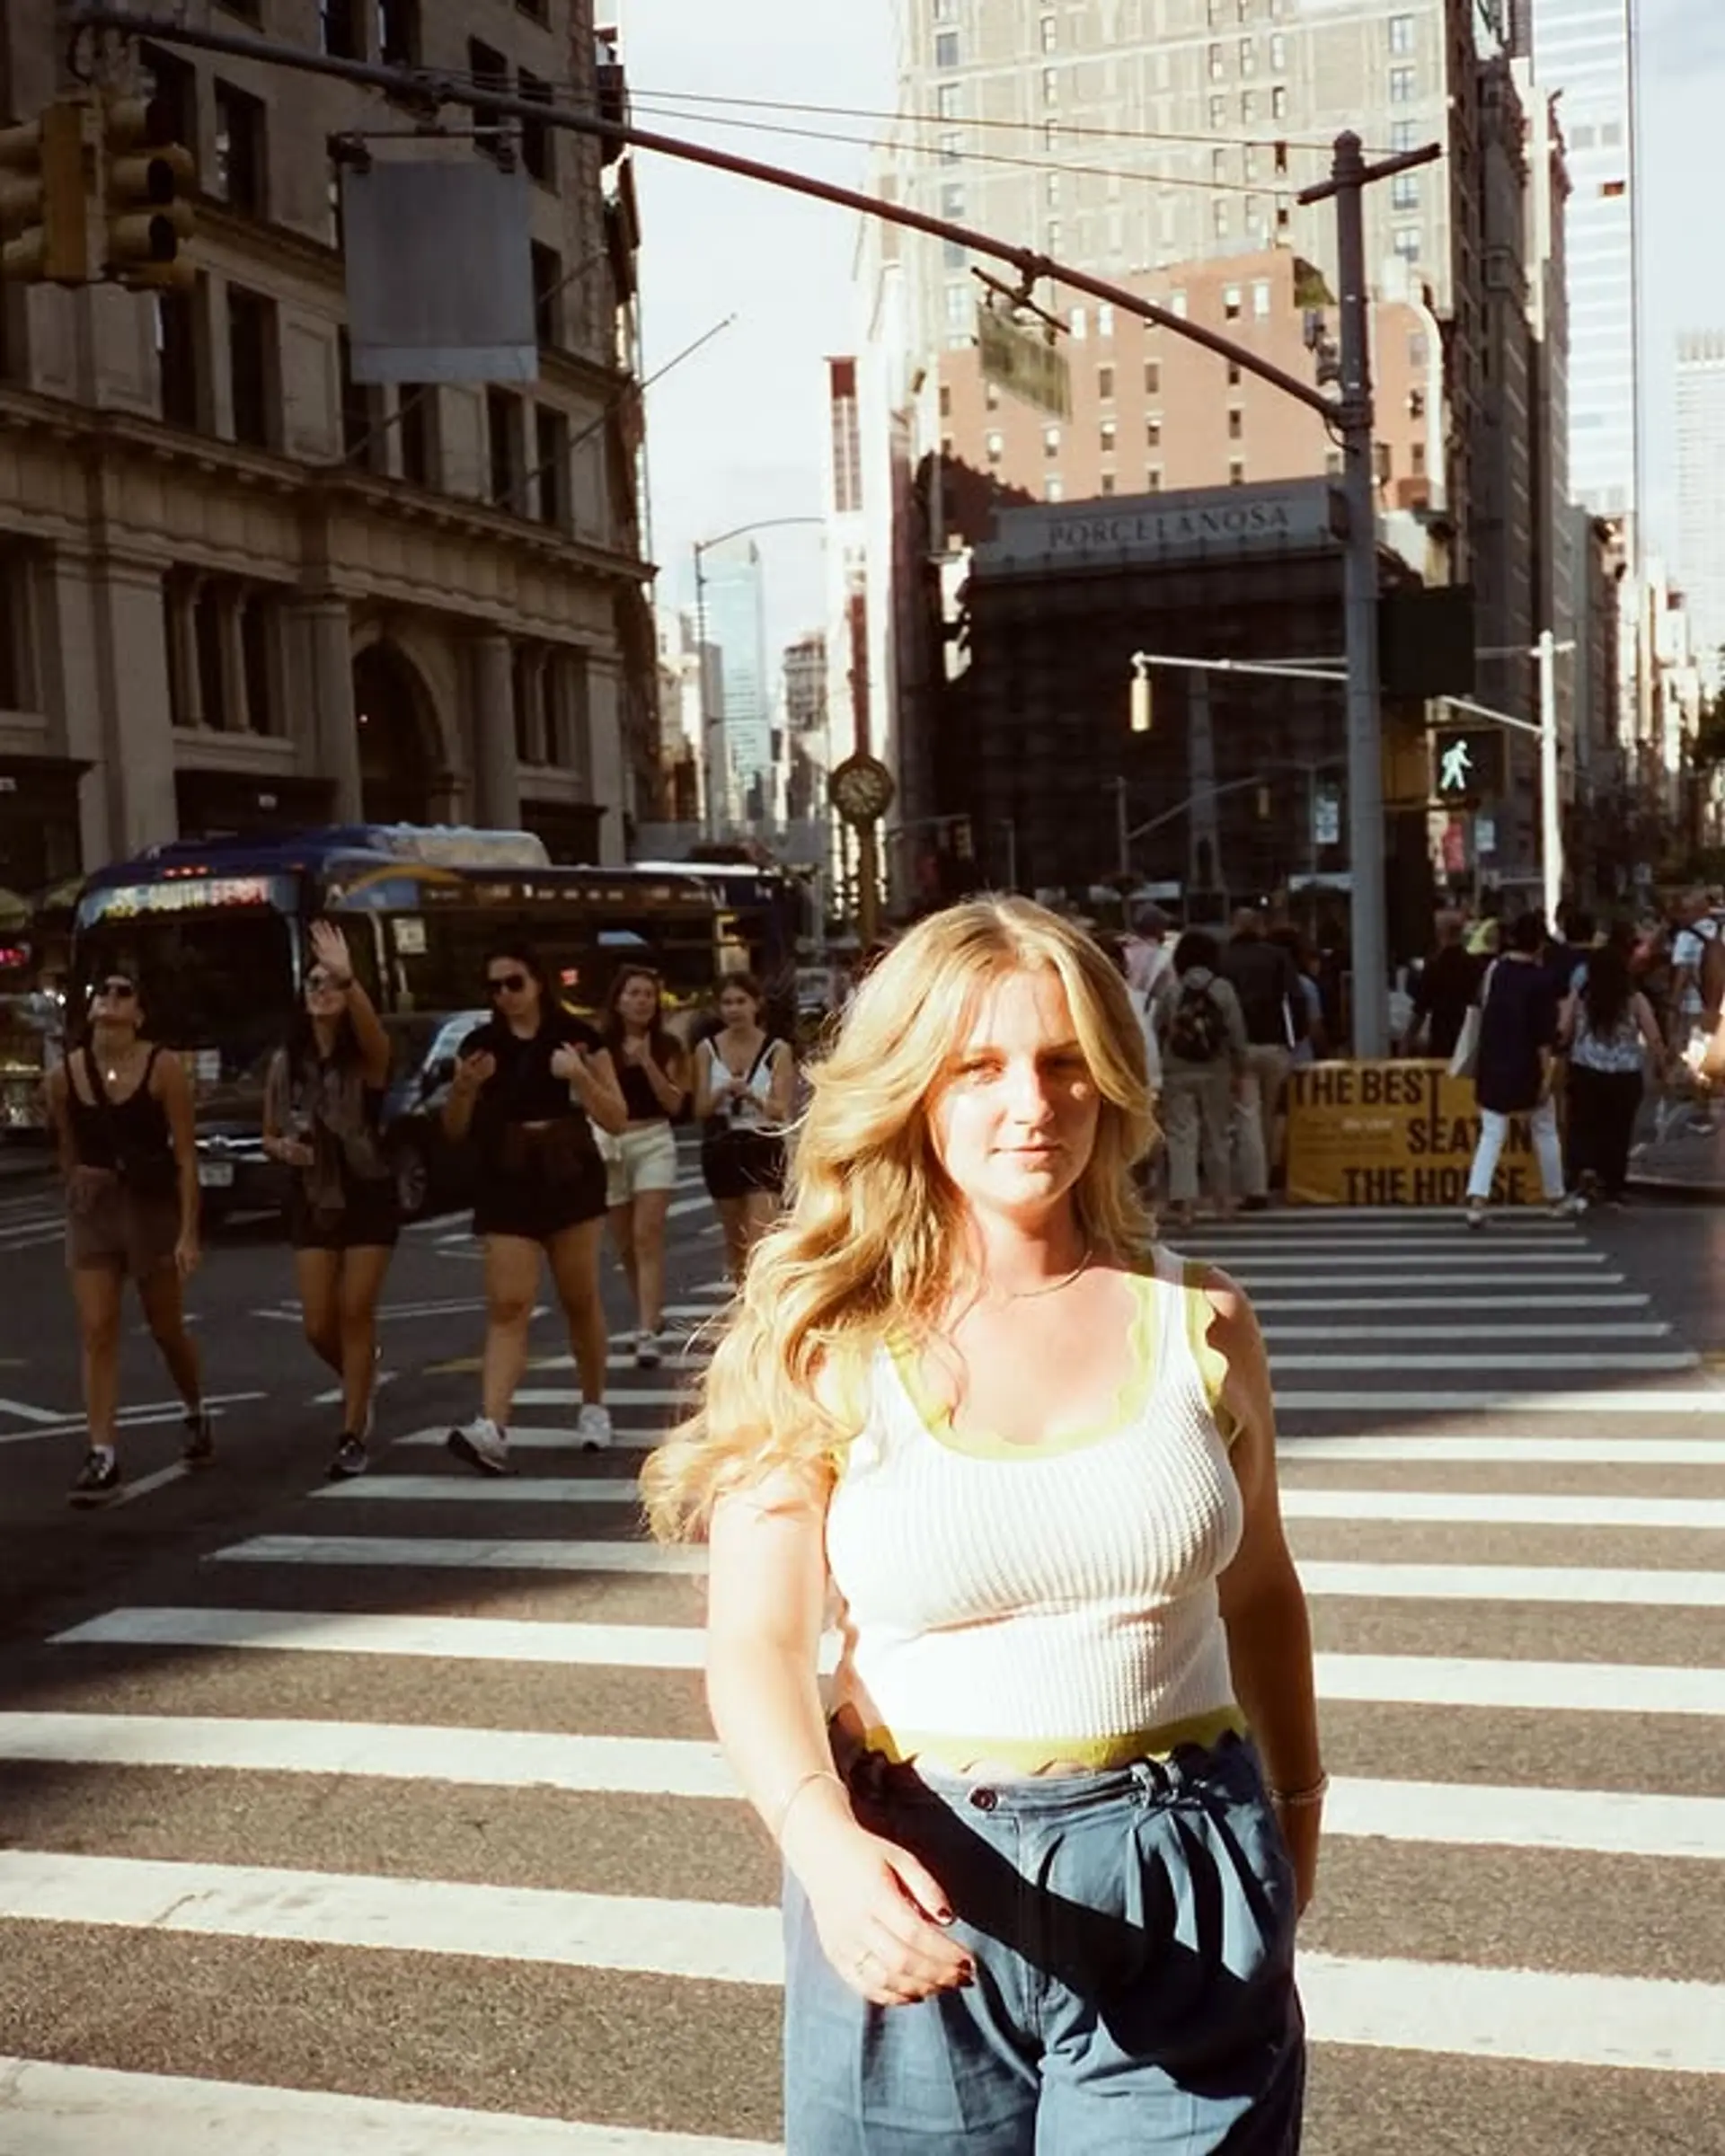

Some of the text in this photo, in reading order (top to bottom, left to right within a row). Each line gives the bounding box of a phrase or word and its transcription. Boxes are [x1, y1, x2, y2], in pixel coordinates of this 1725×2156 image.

[1048, 503, 1289, 549] PORCELANOSA
[1291, 1066, 1446, 1118] THE BEST
[1341, 1166, 1407, 1206] THE
